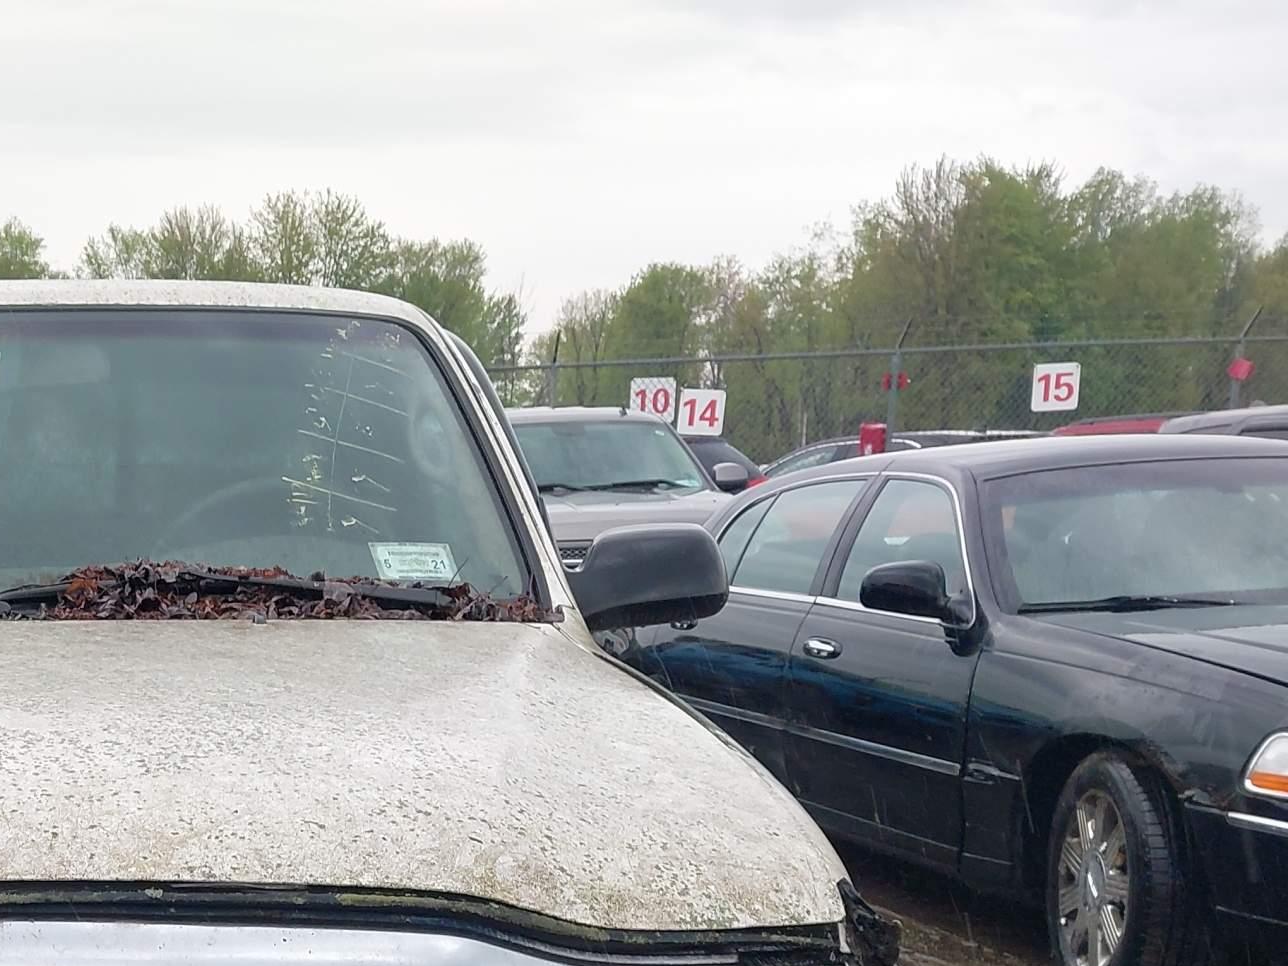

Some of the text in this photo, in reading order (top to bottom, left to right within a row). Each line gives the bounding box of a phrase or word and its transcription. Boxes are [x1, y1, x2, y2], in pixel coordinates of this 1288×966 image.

[635, 388, 671, 414] 10
[1037, 372, 1075, 402] 15
[683, 398, 719, 428] 14
[431, 559, 447, 570] 21
